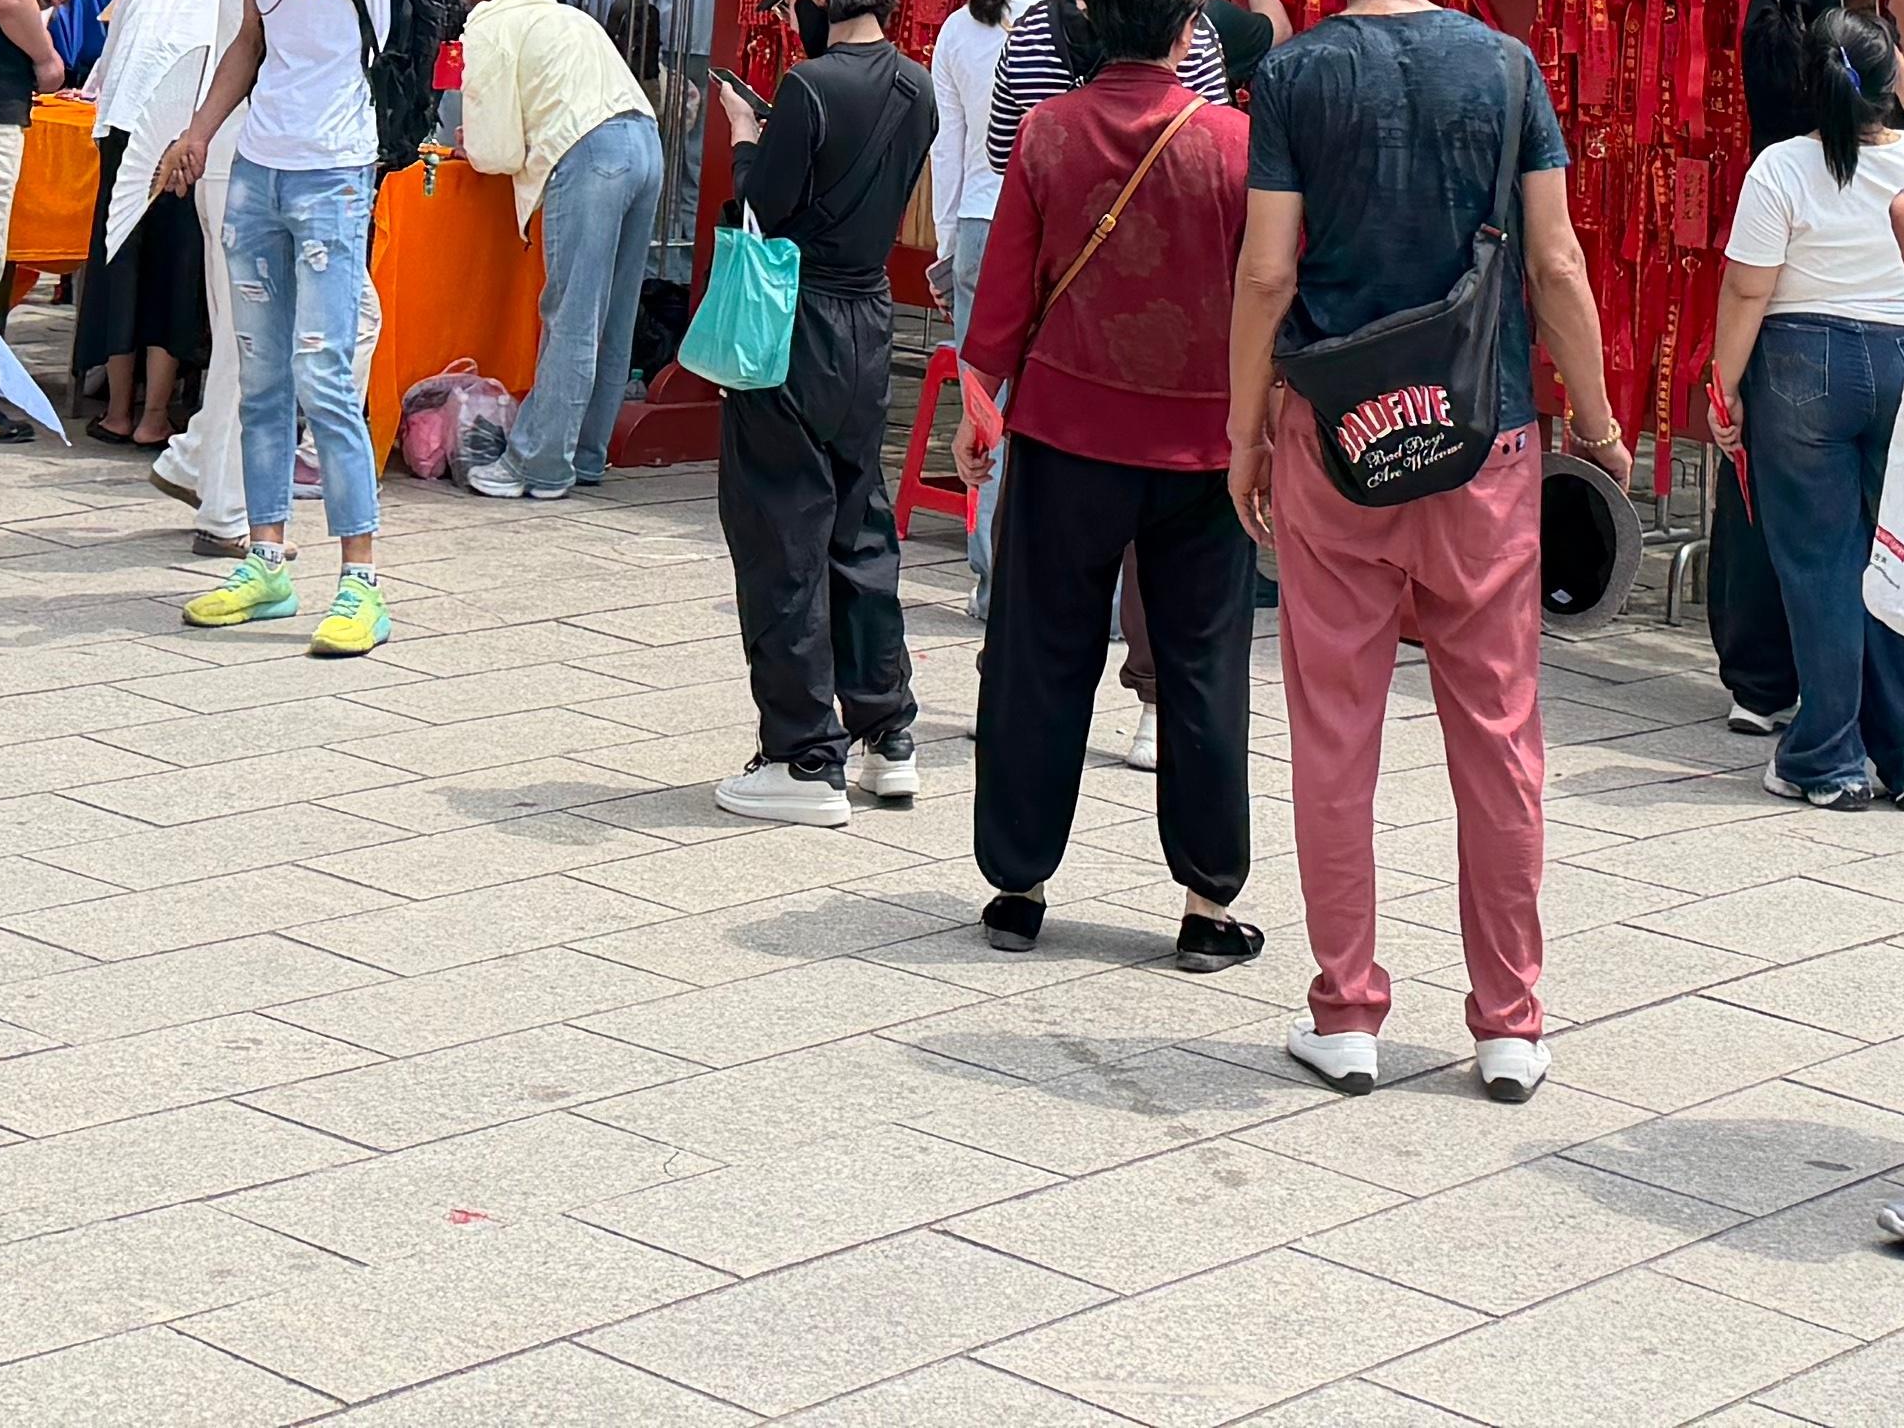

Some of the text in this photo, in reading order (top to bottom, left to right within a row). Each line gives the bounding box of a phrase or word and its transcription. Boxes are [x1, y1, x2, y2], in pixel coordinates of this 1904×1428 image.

[1336, 385, 1454, 464] BADFIVE
[1364, 432, 1445, 468] Bad Boys
[1367, 442, 1464, 488] Are Welcome
